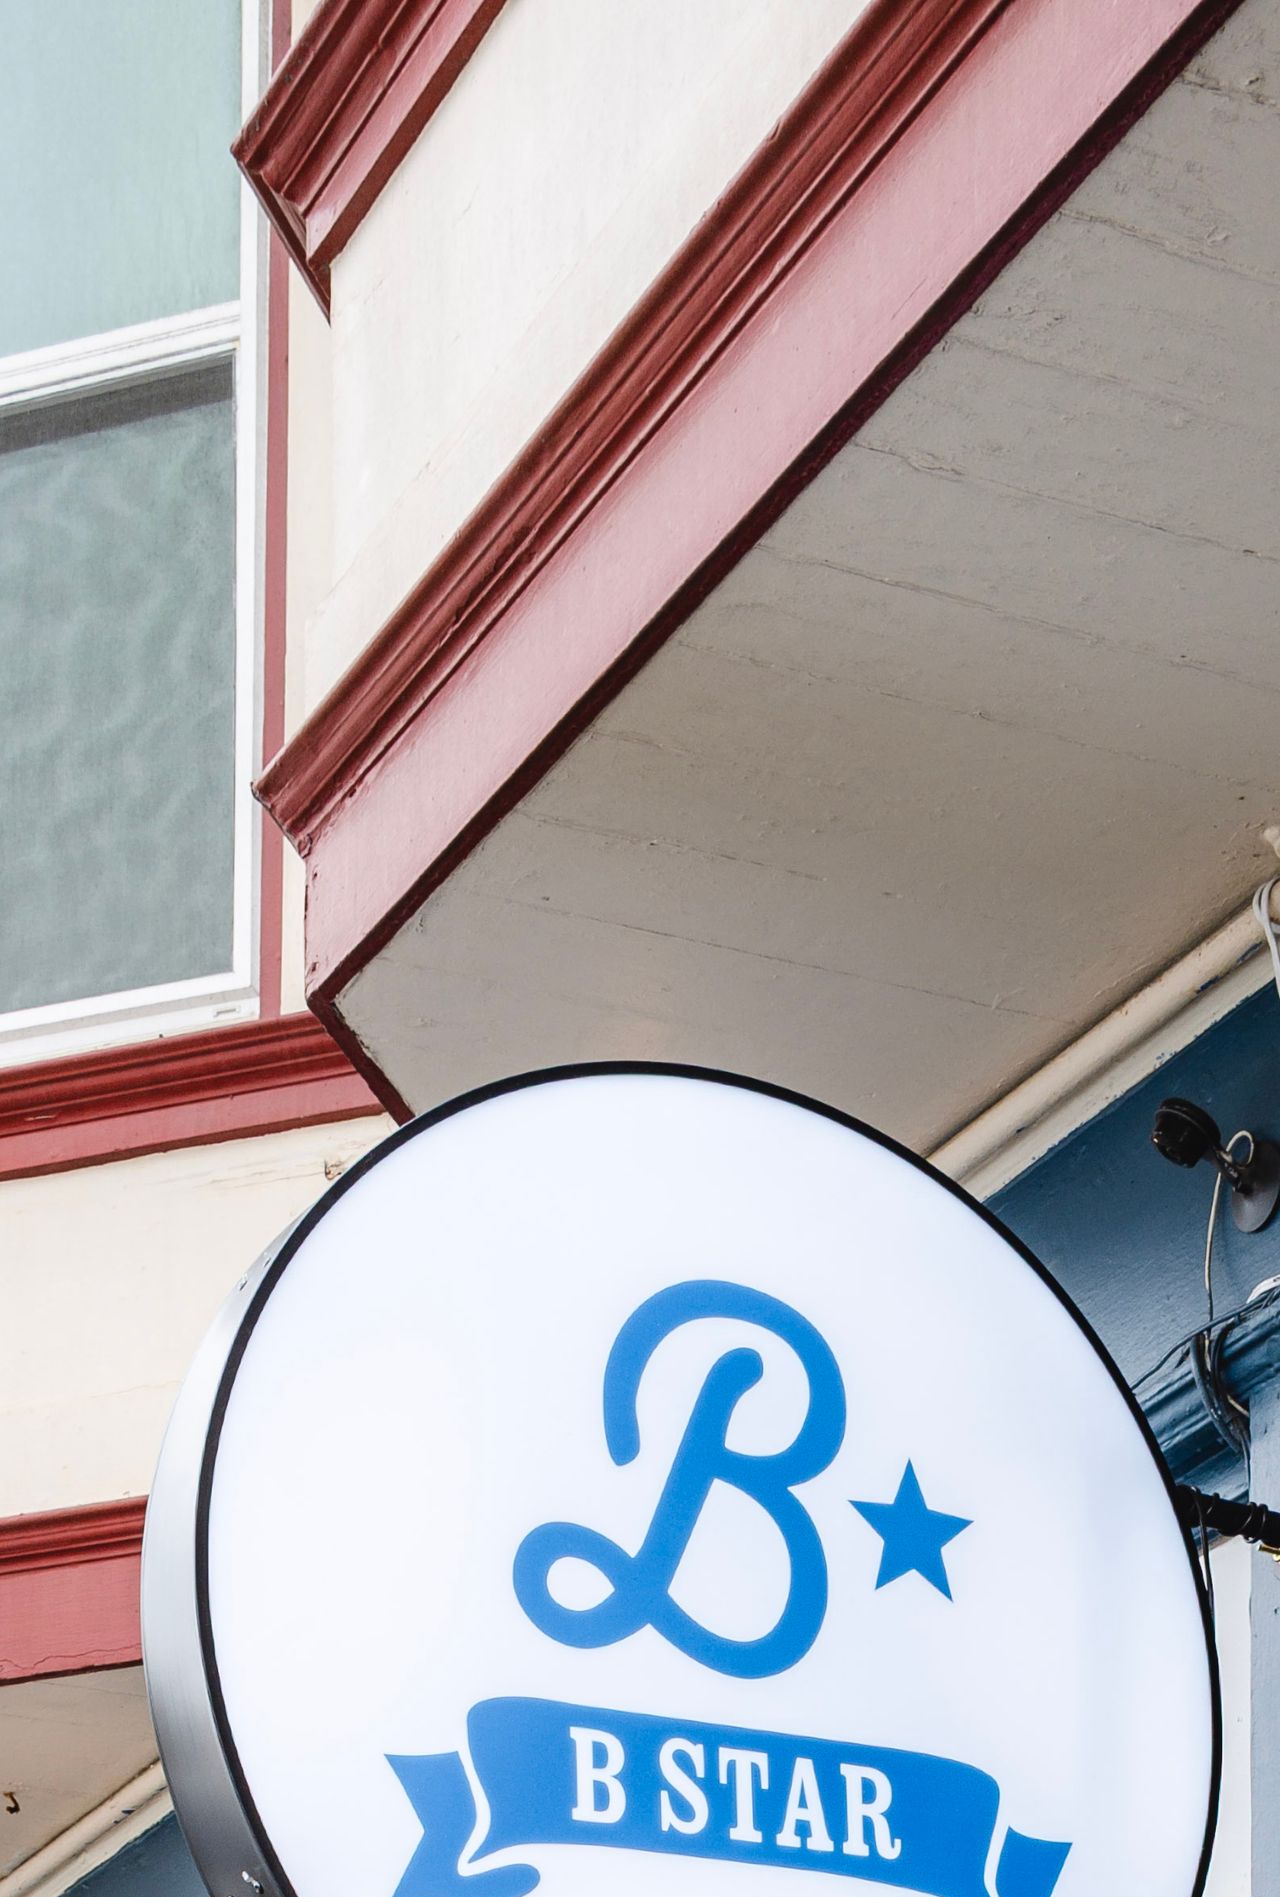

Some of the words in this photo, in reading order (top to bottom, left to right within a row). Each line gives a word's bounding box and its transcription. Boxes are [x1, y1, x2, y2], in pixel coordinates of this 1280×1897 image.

[513, 1279, 846, 1679] B
[570, 1726, 627, 1824] B
[659, 1736, 902, 1860] STAR
